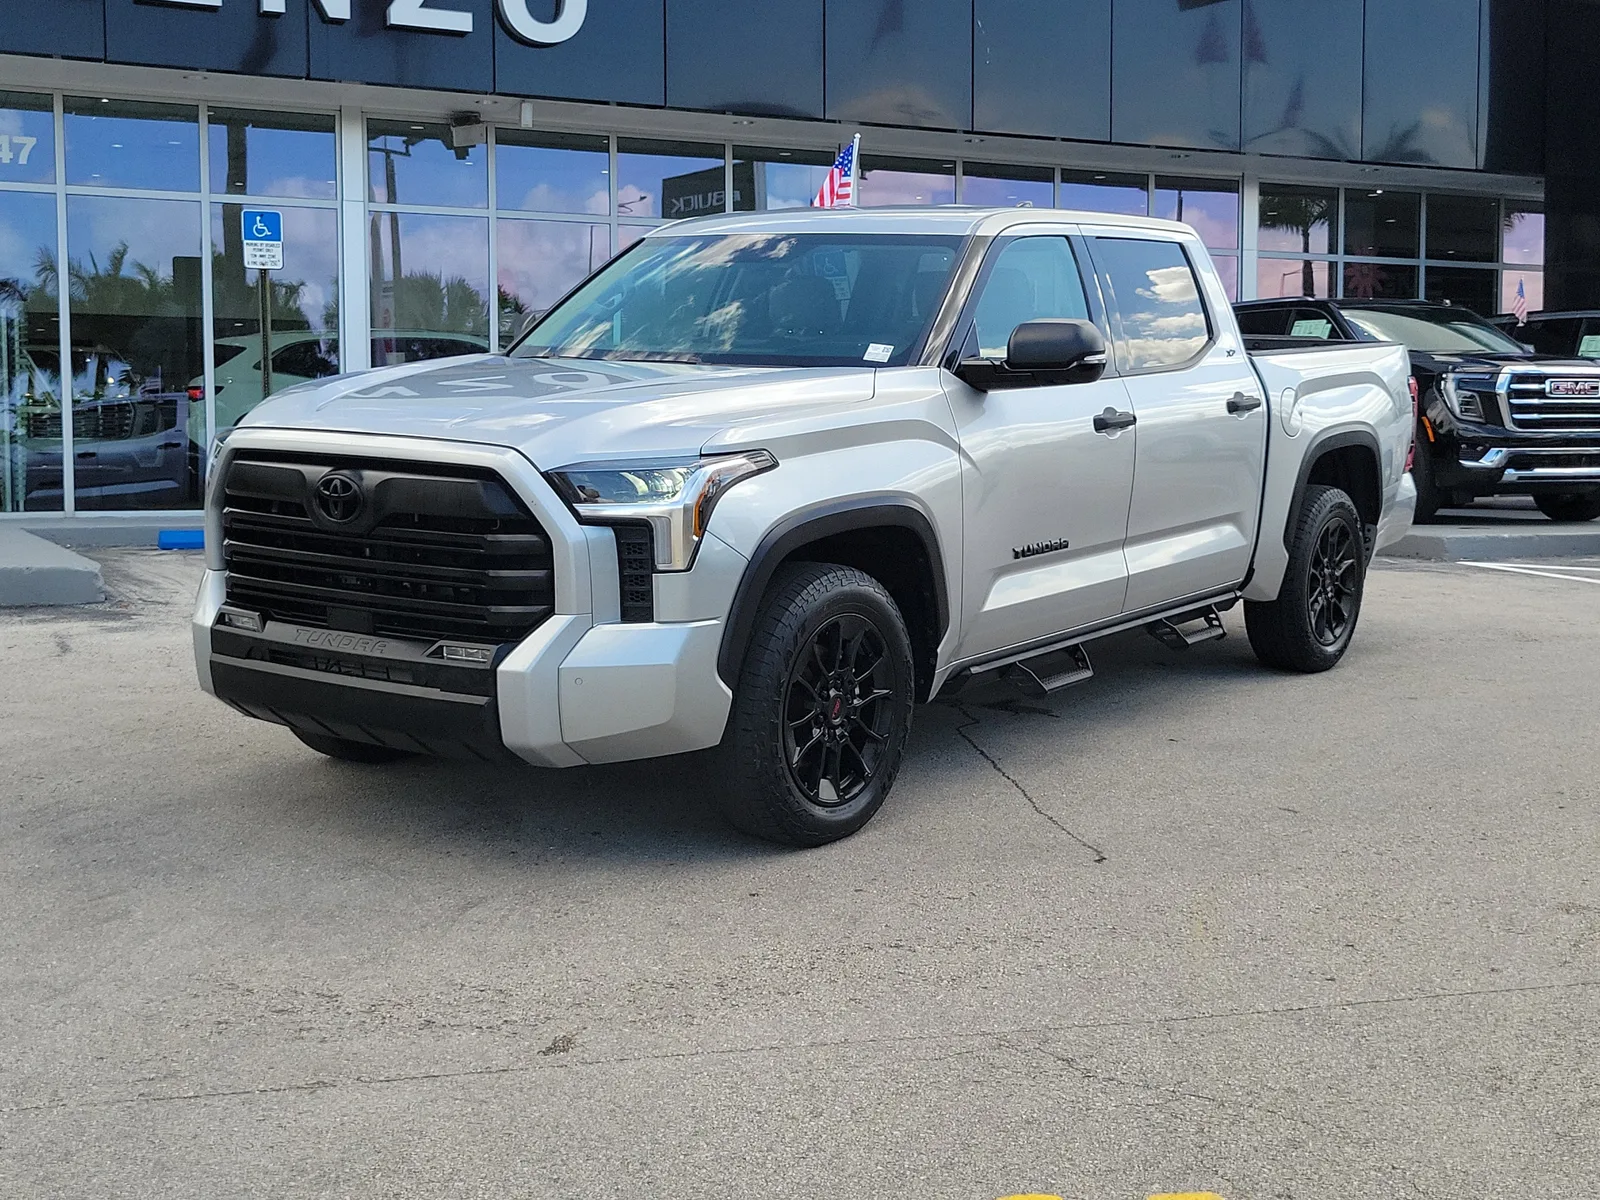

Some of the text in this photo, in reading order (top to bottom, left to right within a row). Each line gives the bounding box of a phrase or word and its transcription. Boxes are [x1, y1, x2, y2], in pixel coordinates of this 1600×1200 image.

[1551, 381, 1599, 395] GMC
[1011, 537, 1069, 560] TUNDRA
[294, 628, 390, 655] TUNDRA
